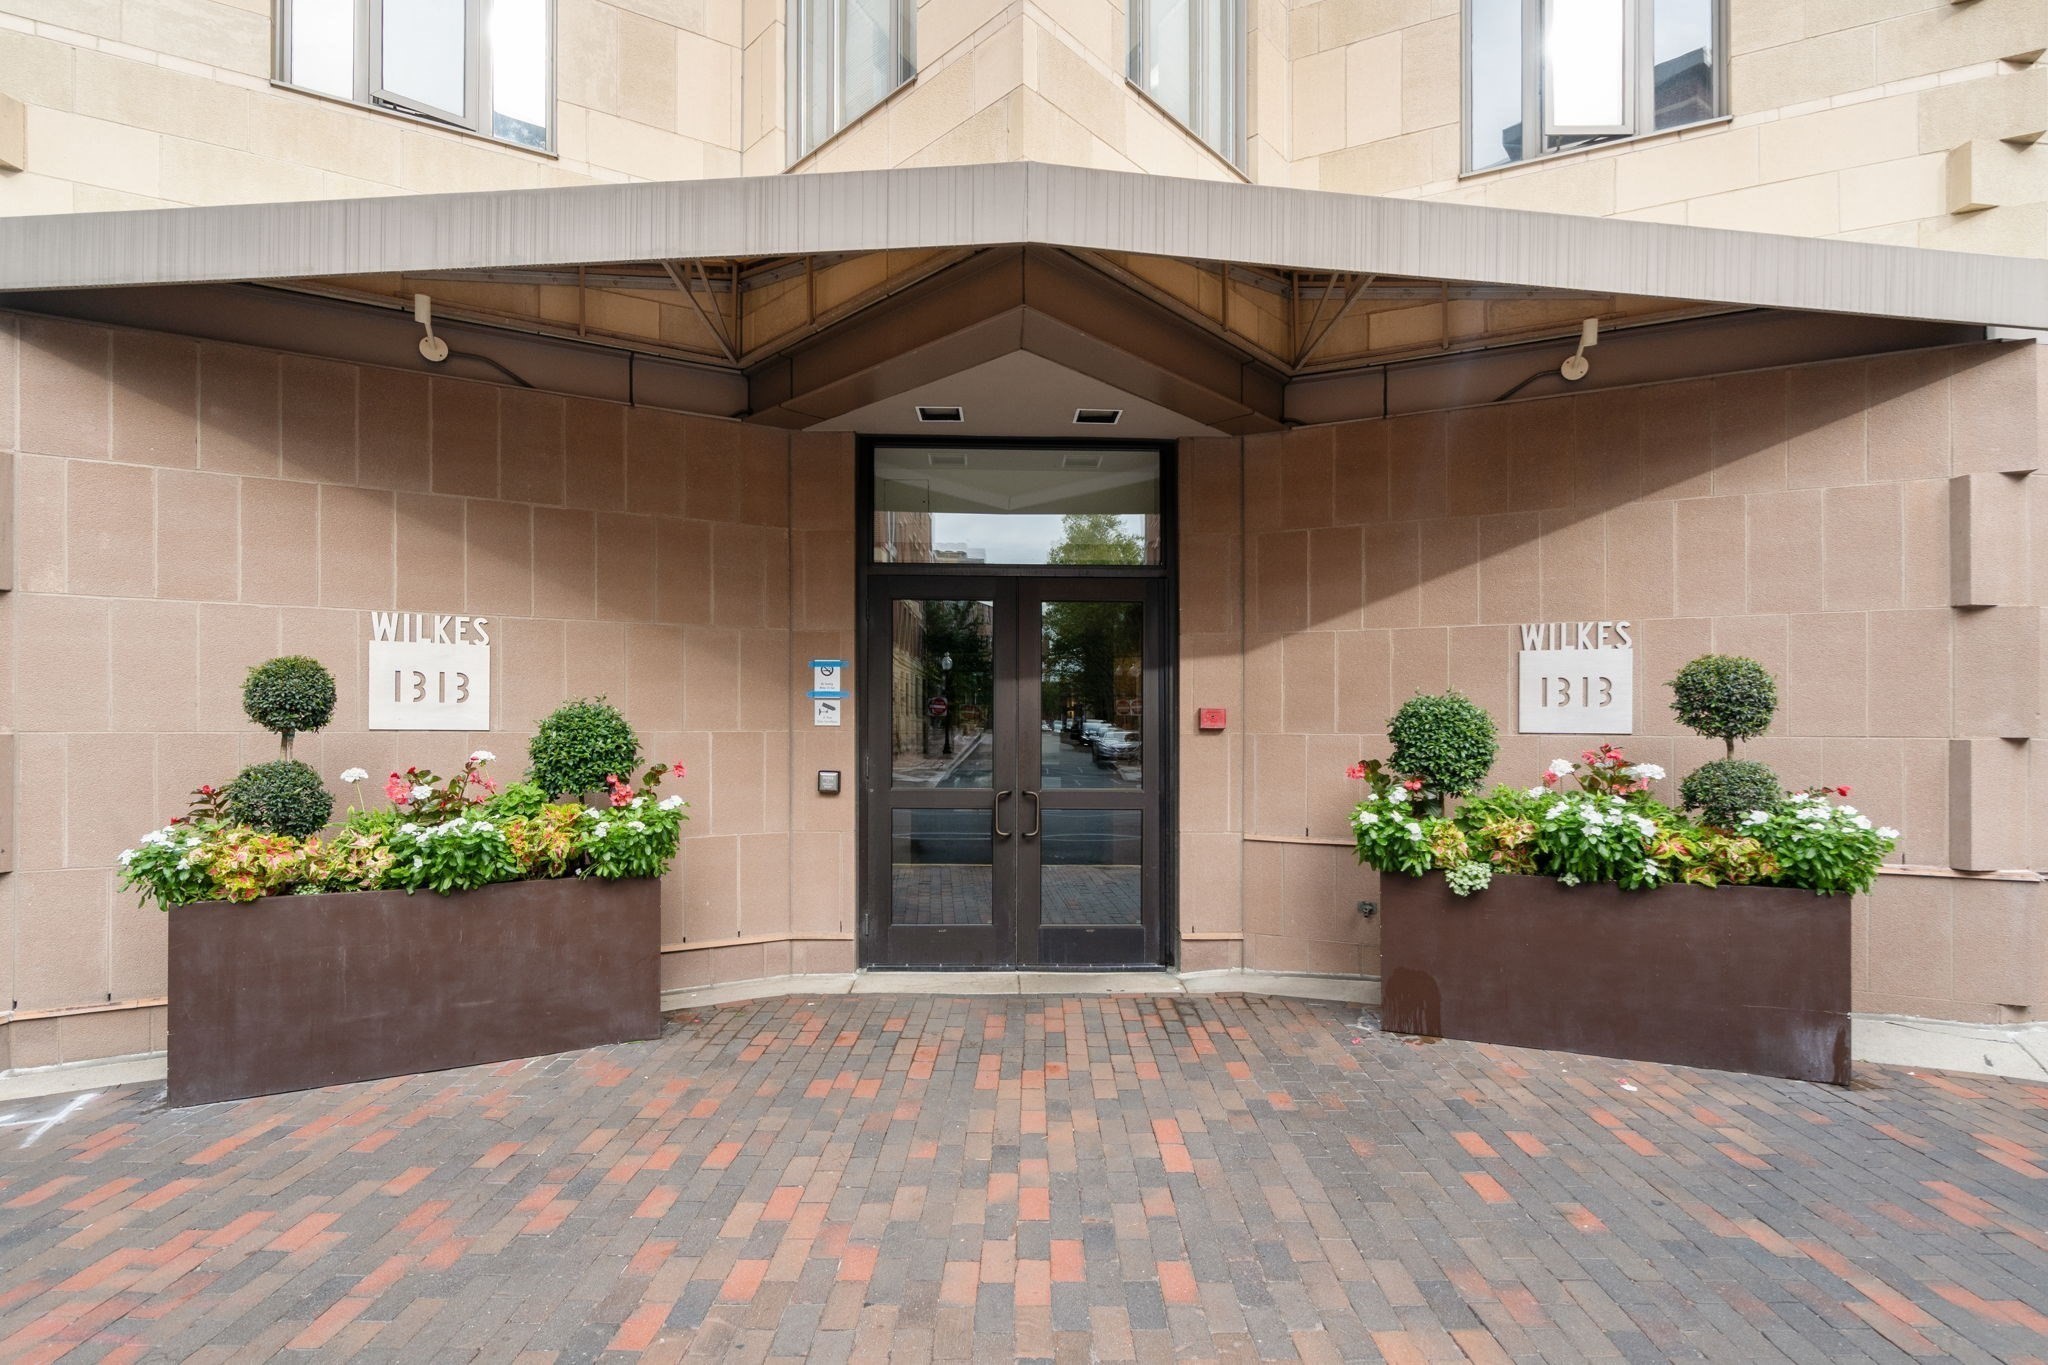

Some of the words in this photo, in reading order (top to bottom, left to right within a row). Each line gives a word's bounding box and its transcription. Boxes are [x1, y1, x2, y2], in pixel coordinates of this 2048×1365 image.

[371, 611, 489, 646] WILKES
[1520, 620, 1633, 651] WILKES
[394, 670, 470, 704] 1313
[1541, 676, 1612, 708] 1313
